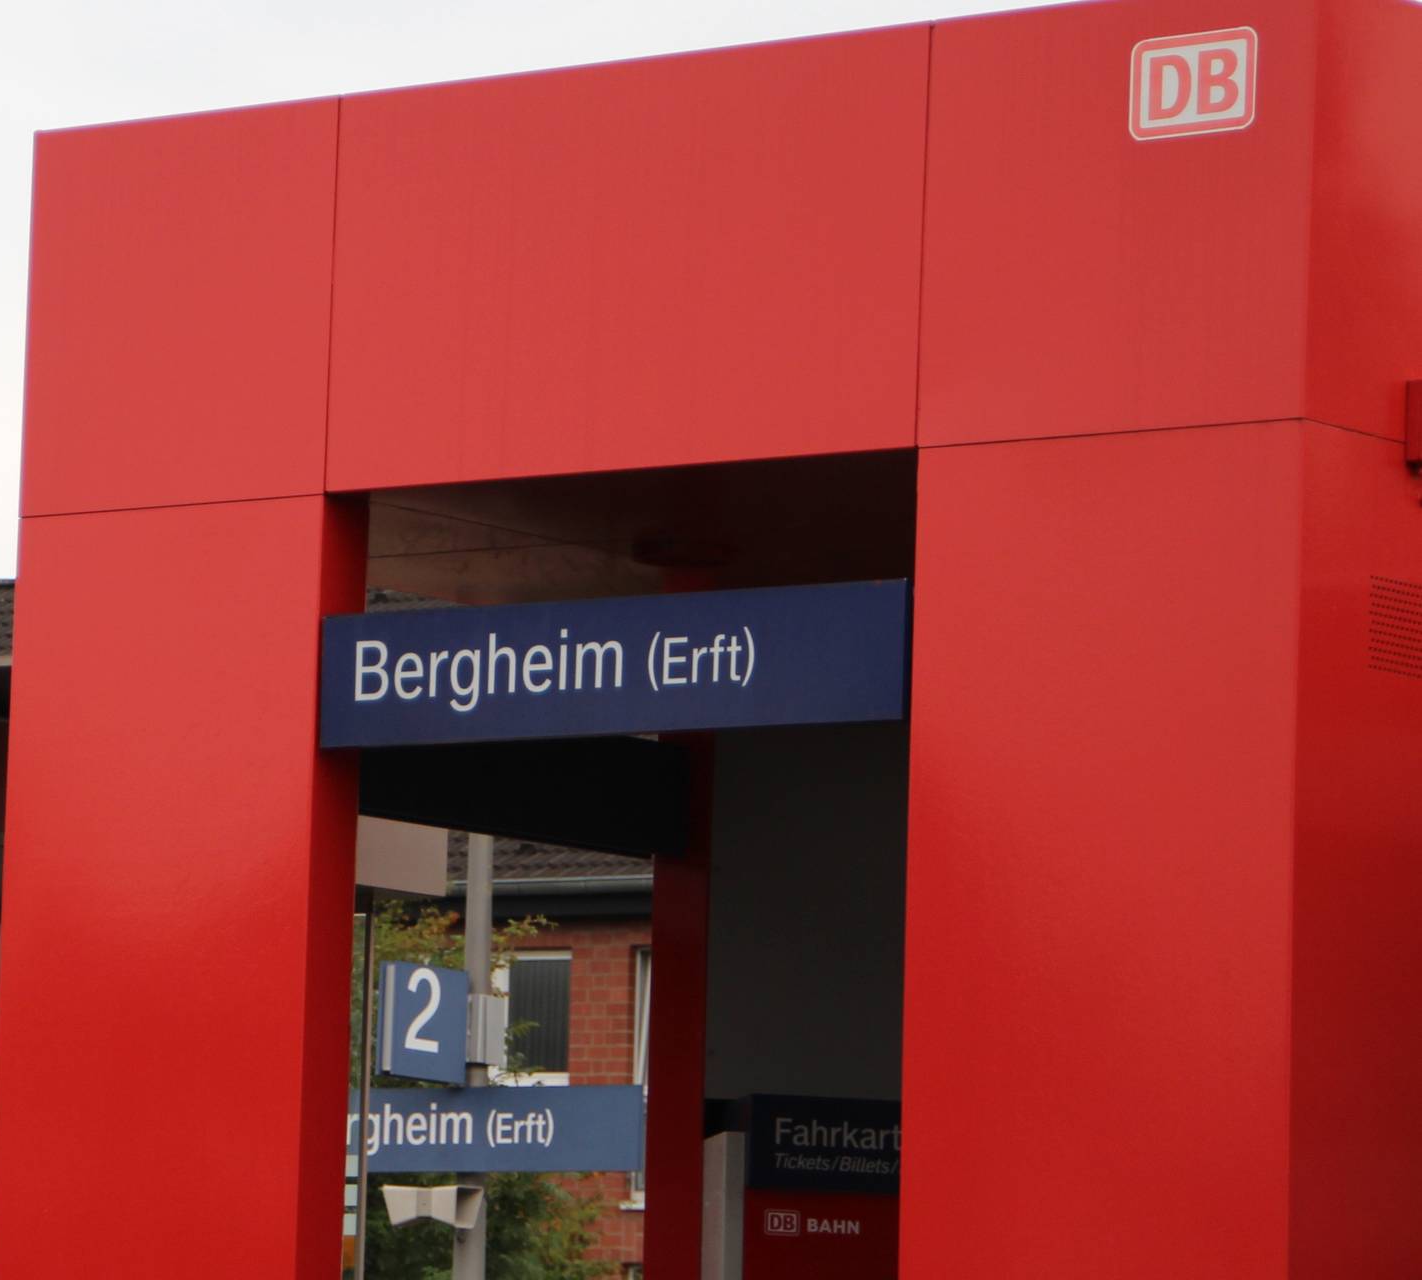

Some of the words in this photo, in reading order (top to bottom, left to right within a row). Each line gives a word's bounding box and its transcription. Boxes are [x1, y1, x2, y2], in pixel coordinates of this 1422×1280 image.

[1145, 45, 1242, 123] DB
[353, 628, 624, 712] Bergheim
[647, 626, 756, 692] (Erft)
[403, 967, 442, 1053] 2
[346, 1103, 473, 1156] rgheim
[486, 1108, 555, 1148] (Erft)
[774, 1117, 902, 1151] Fahrkart
[768, 1212, 797, 1232] DB
[807, 1218, 860, 1235] BAHN
